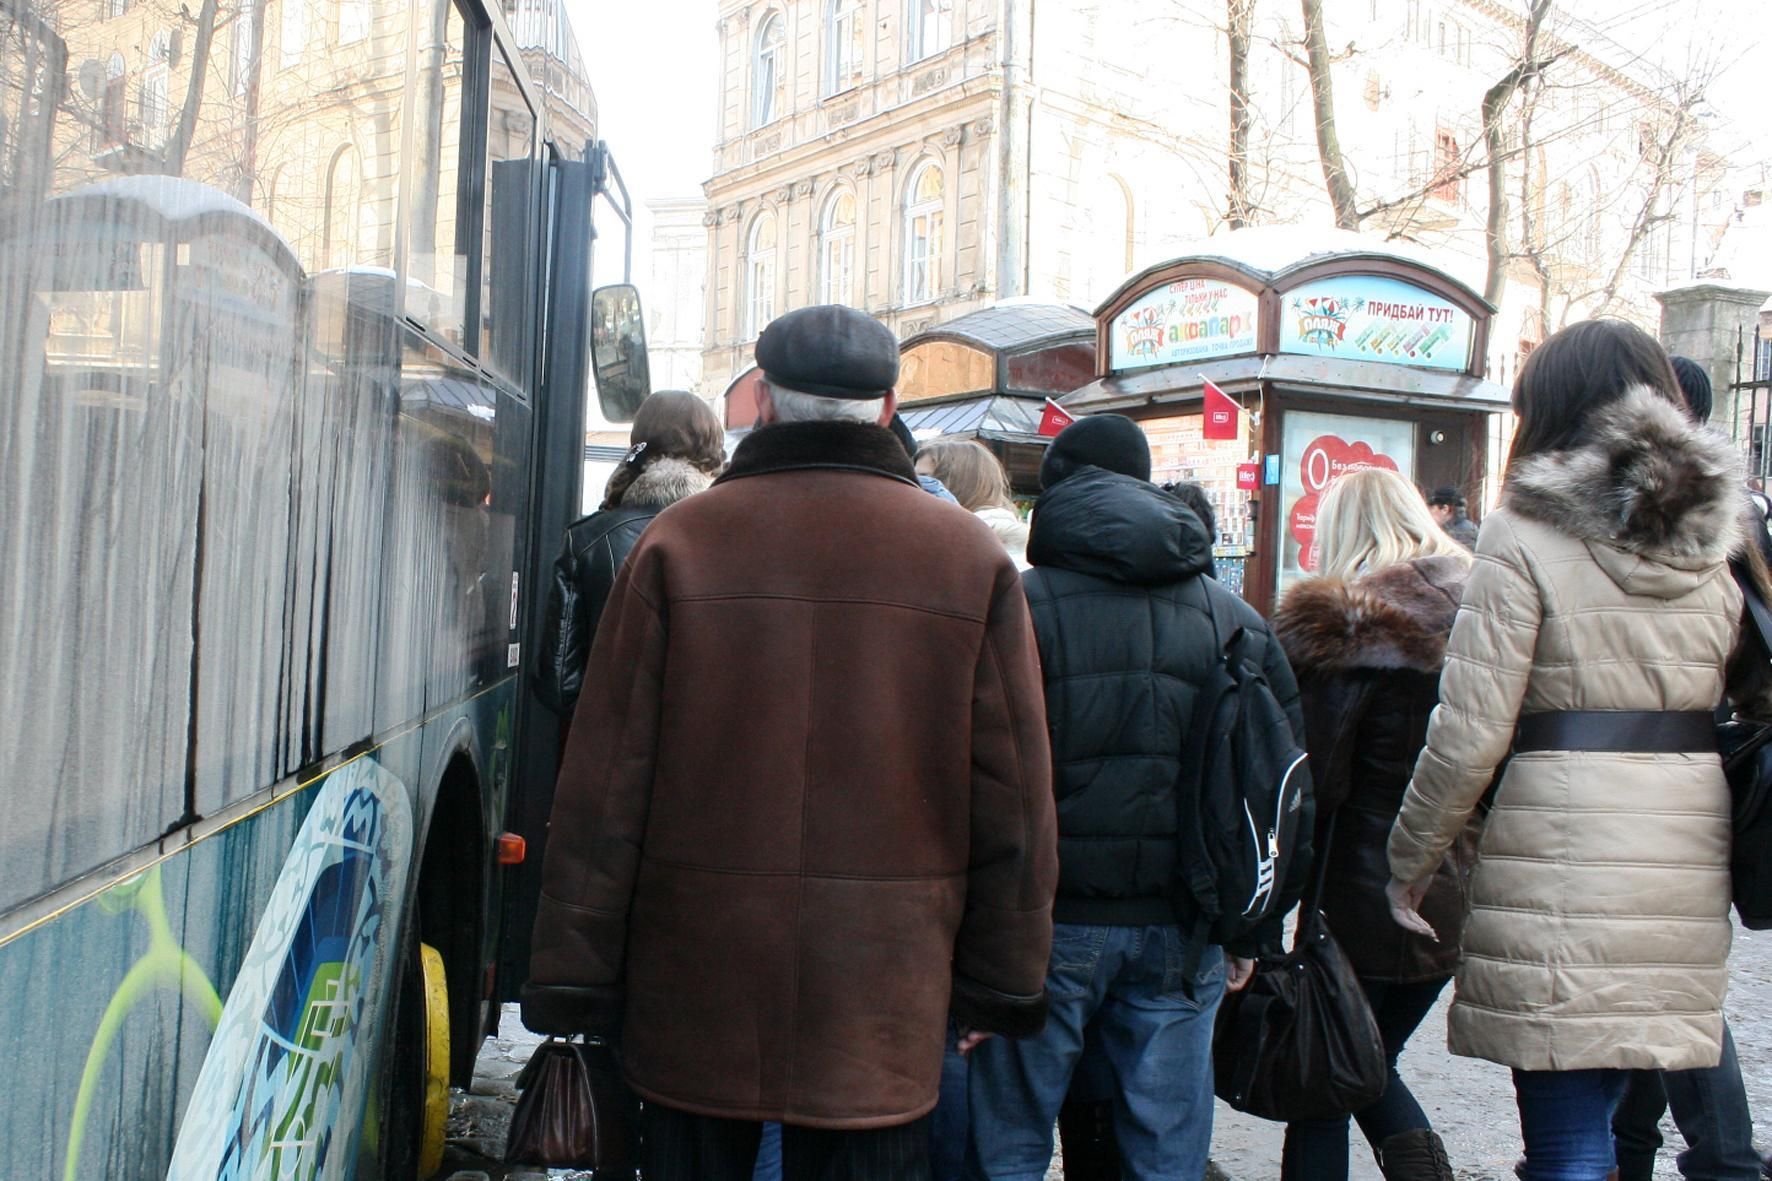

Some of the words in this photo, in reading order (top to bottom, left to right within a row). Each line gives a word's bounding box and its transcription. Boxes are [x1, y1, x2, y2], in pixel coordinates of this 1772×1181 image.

[1169, 281, 1188, 294] СУПЕР
[1214, 287, 1228, 299] НАС
[1368, 301, 1424, 321] ПРИДБАЙ
[1428, 307, 1454, 324] ТУТ!
